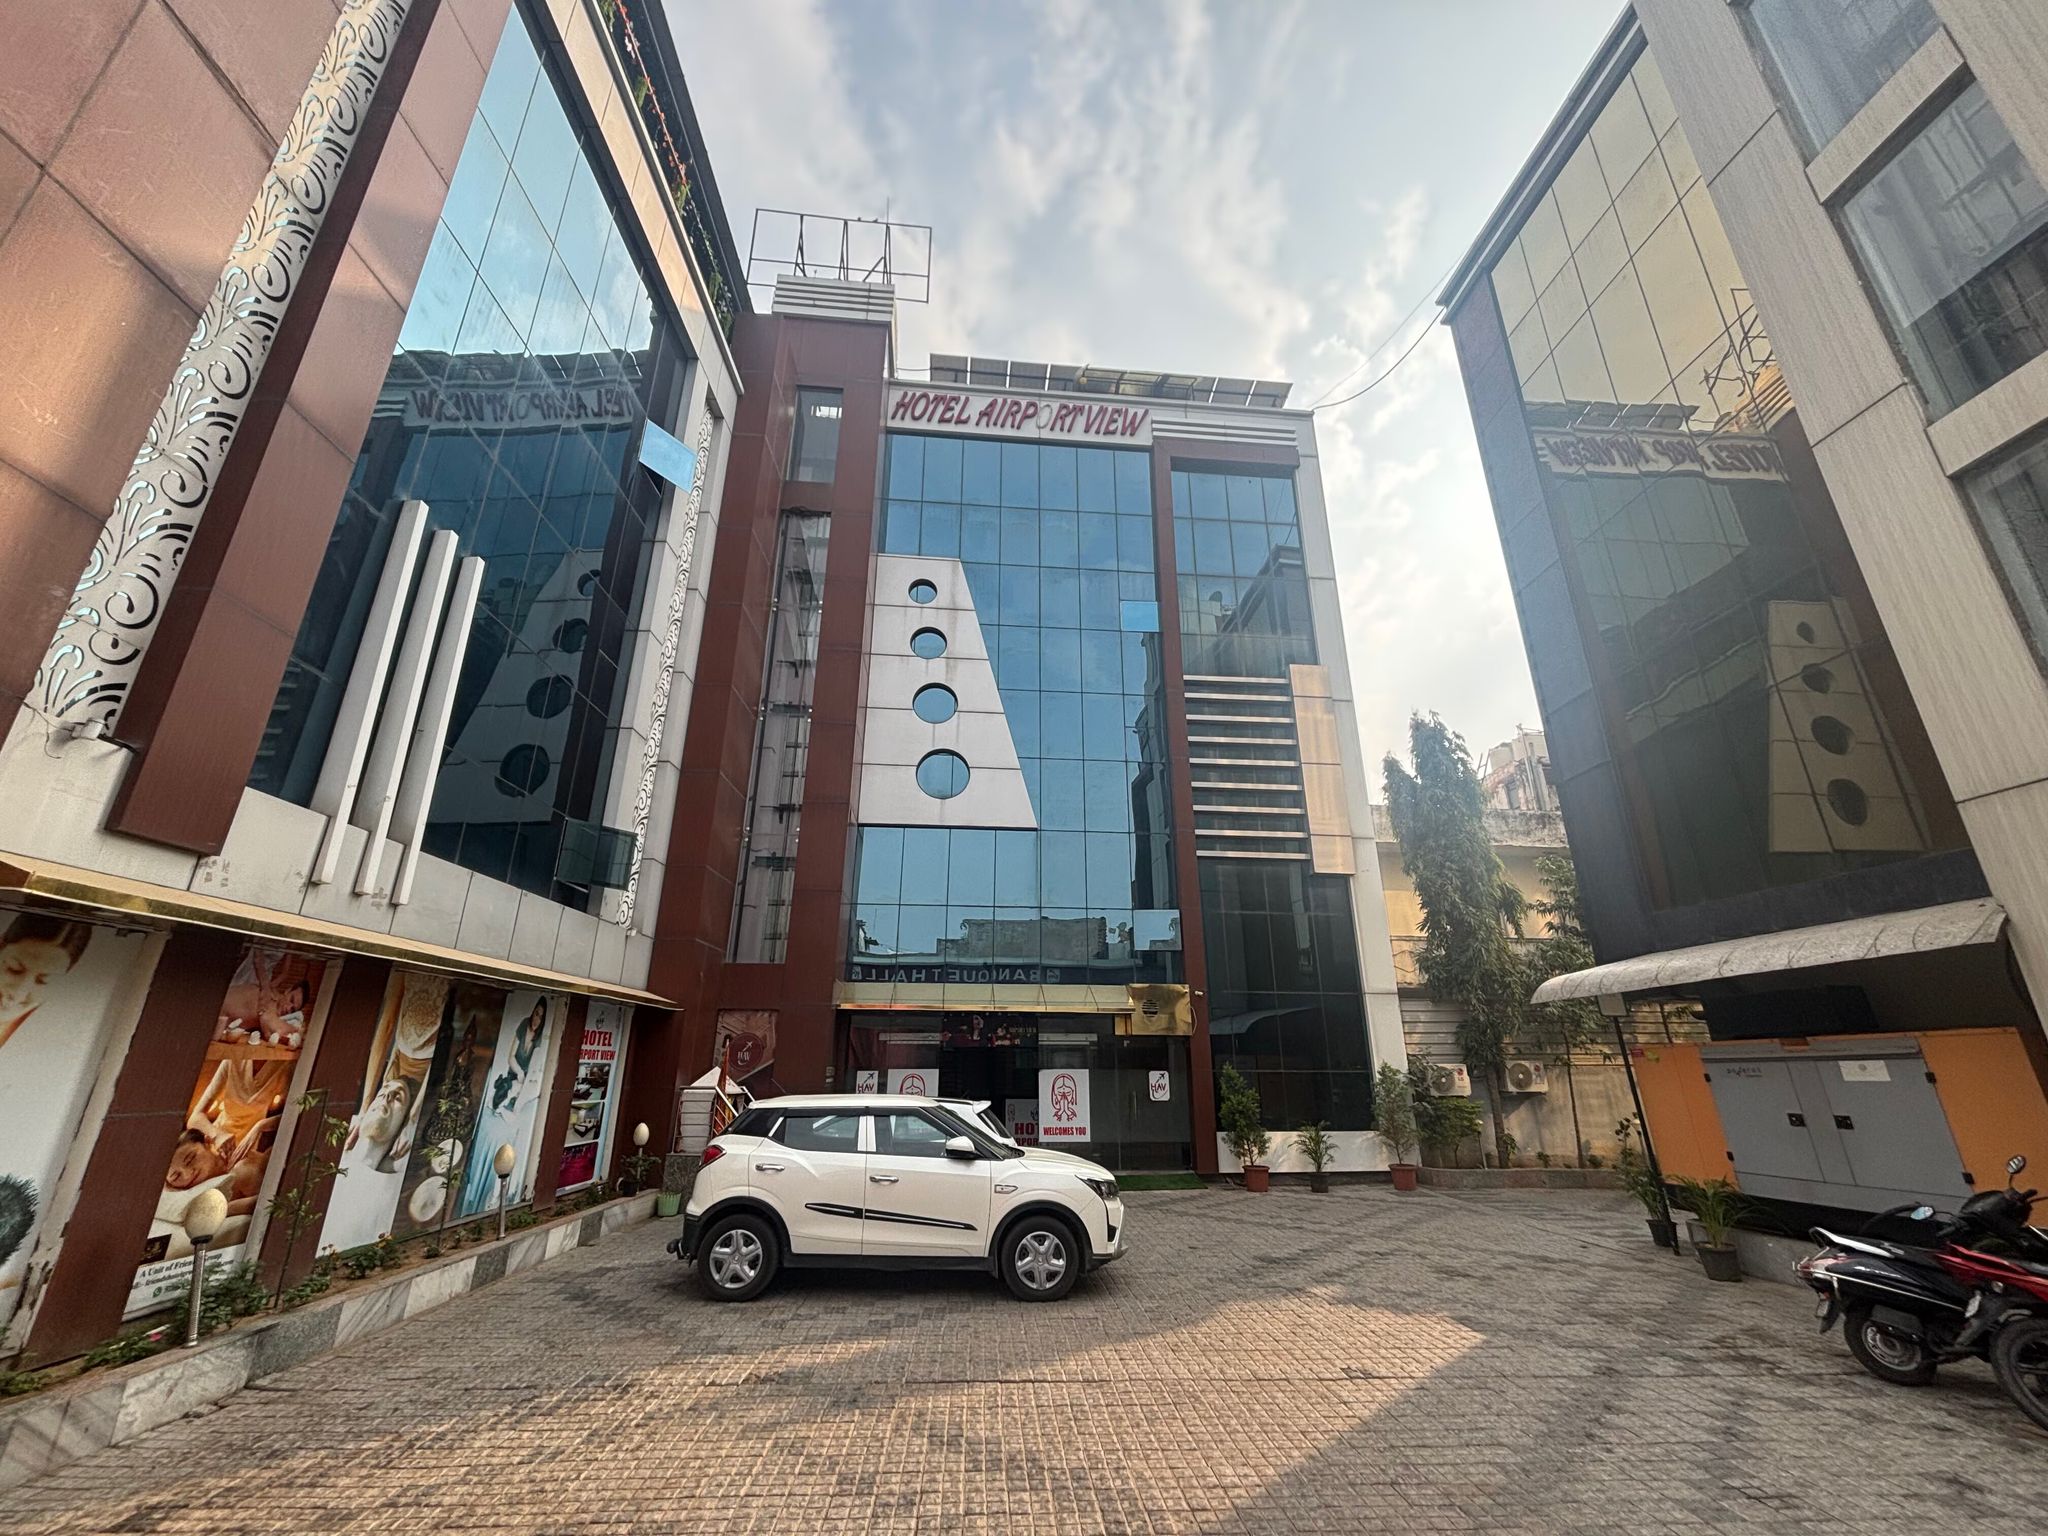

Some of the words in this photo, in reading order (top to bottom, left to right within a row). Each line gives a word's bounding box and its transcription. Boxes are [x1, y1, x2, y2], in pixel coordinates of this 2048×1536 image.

[891, 391, 971, 425] HOTEL
[975, 397, 1083, 433] AIRPORT
[1079, 405, 1149, 436] VIEW
[583, 1030, 612, 1047] HOTEL
[601, 1051, 616, 1061] VIEW
[1151, 1083, 1166, 1093] HAV
[1043, 1126, 1074, 1136] WELCOMES
[1075, 1126, 1087, 1136] YOU
